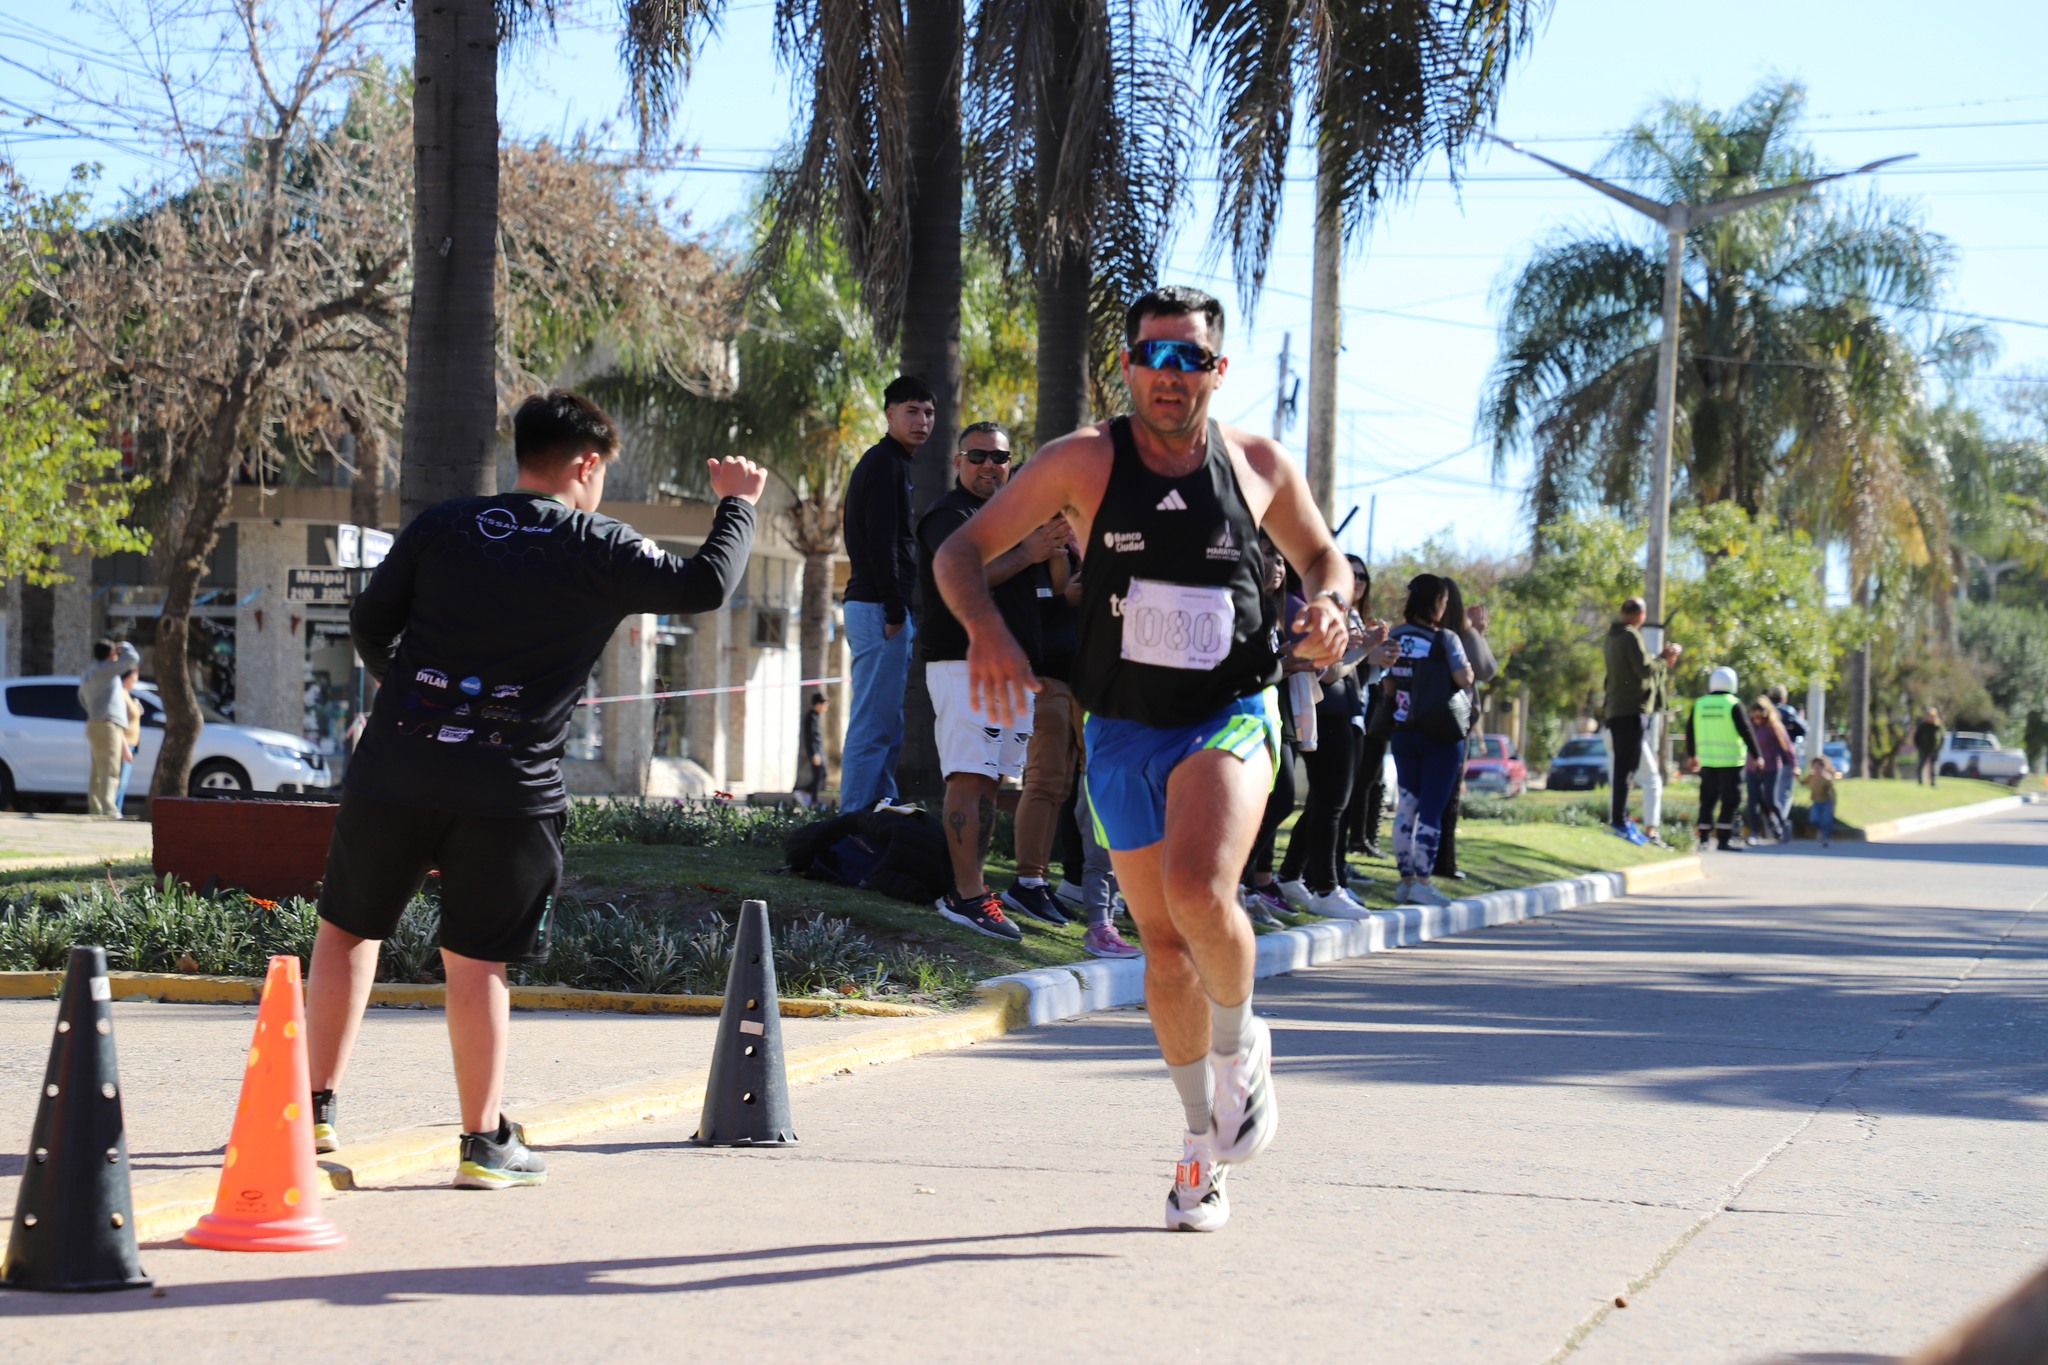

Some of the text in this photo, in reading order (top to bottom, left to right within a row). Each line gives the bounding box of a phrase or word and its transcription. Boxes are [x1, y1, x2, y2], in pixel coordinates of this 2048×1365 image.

[475, 514, 518, 531] NISSAN
[1114, 532, 1142, 543] Banco
[1115, 540, 1145, 552] Ciudad
[296, 570, 345, 586] Maipú
[1135, 607, 1222, 653] 080
[415, 671, 448, 689] DYLAN
